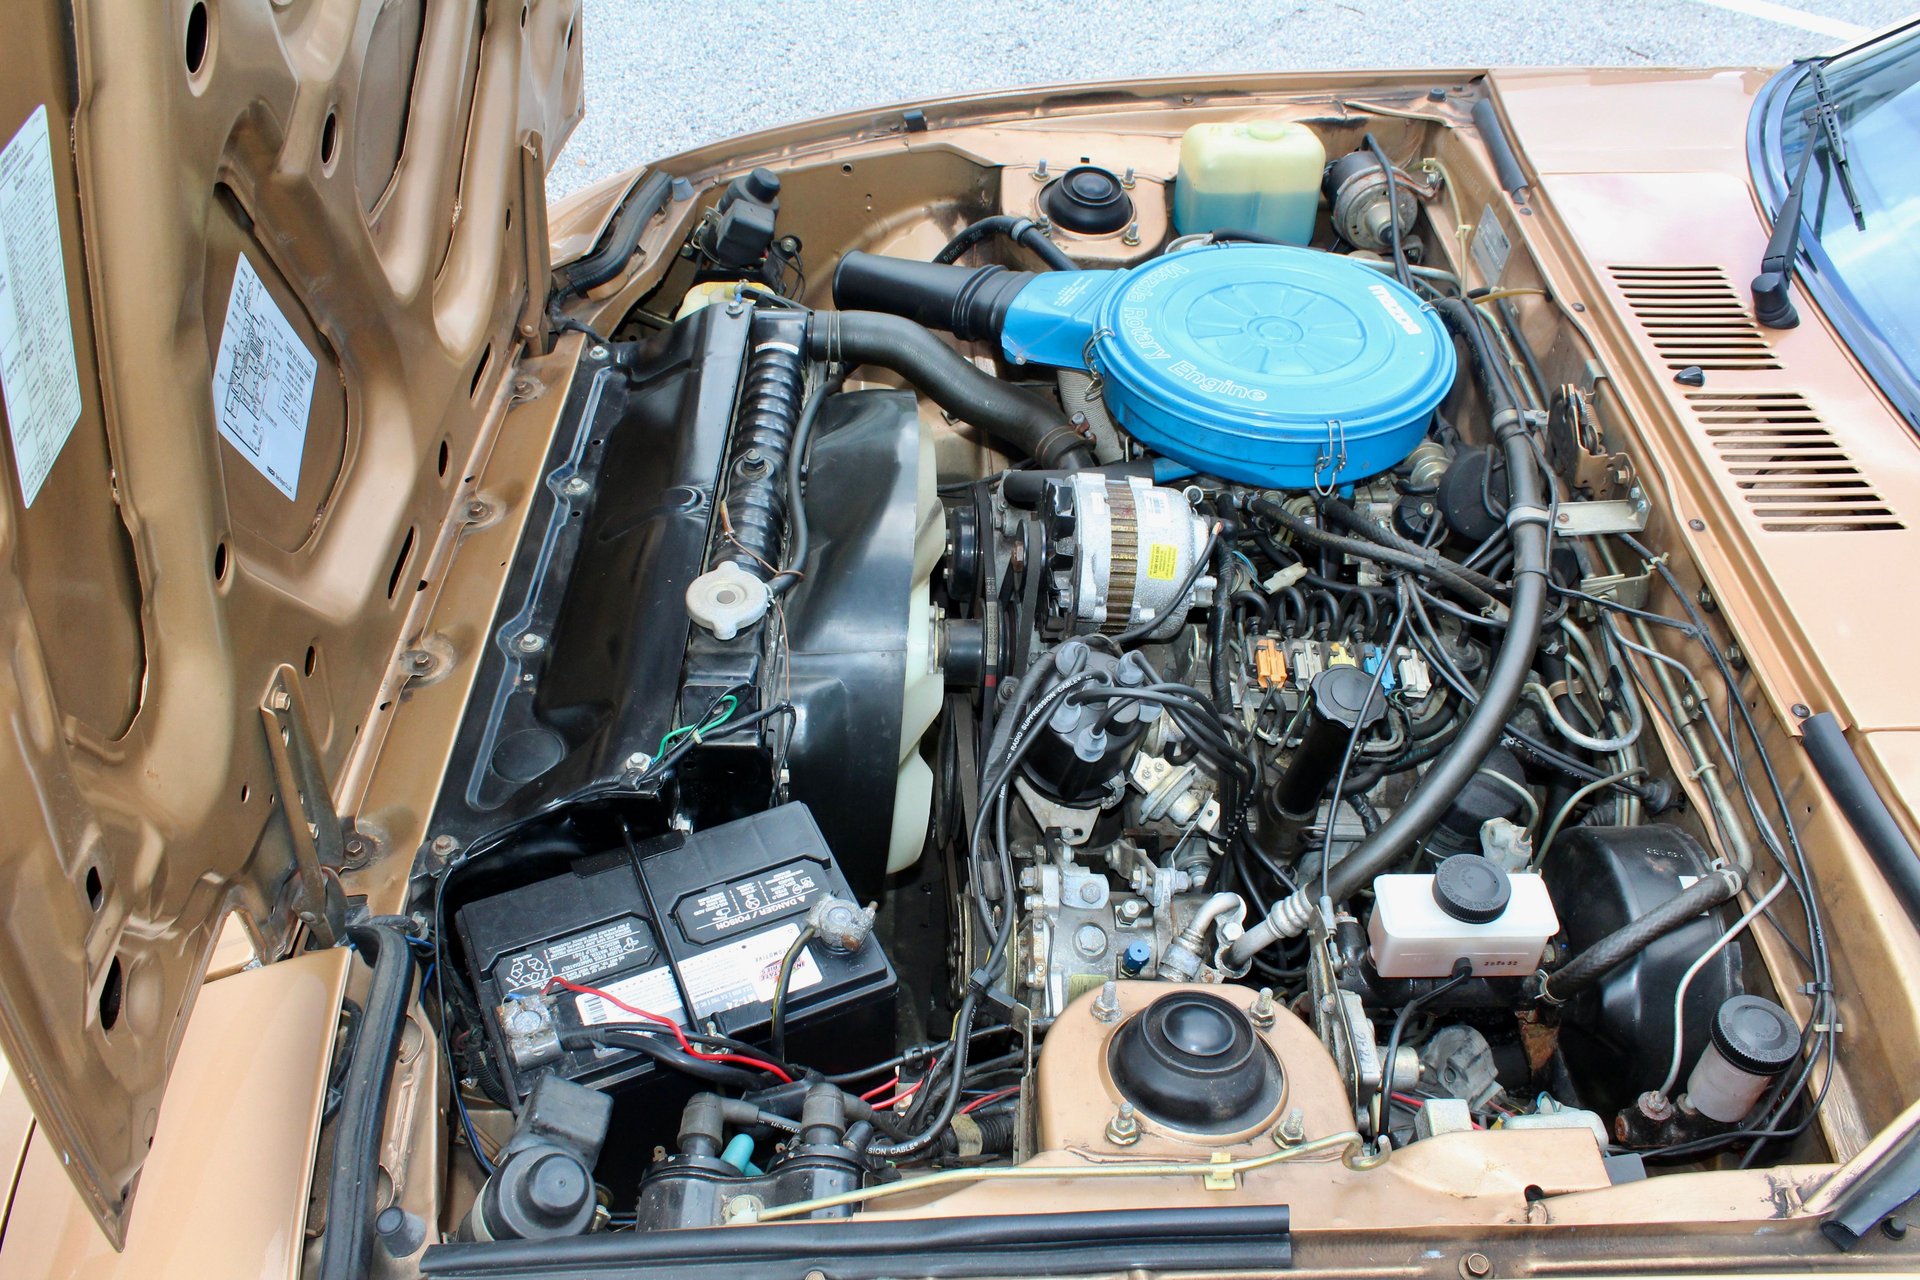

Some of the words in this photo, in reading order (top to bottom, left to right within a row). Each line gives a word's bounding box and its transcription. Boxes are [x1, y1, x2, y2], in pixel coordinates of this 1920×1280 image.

[1127, 262, 1190, 303] Mazda
[1124, 307, 1171, 360] Rotary
[1168, 360, 1267, 402] Engine
[1010, 732, 1023, 752] RADIO
[1021, 692, 1056, 731] SUPPRESSION
[715, 913, 751, 930] POISON
[758, 898, 797, 915] DANGER
